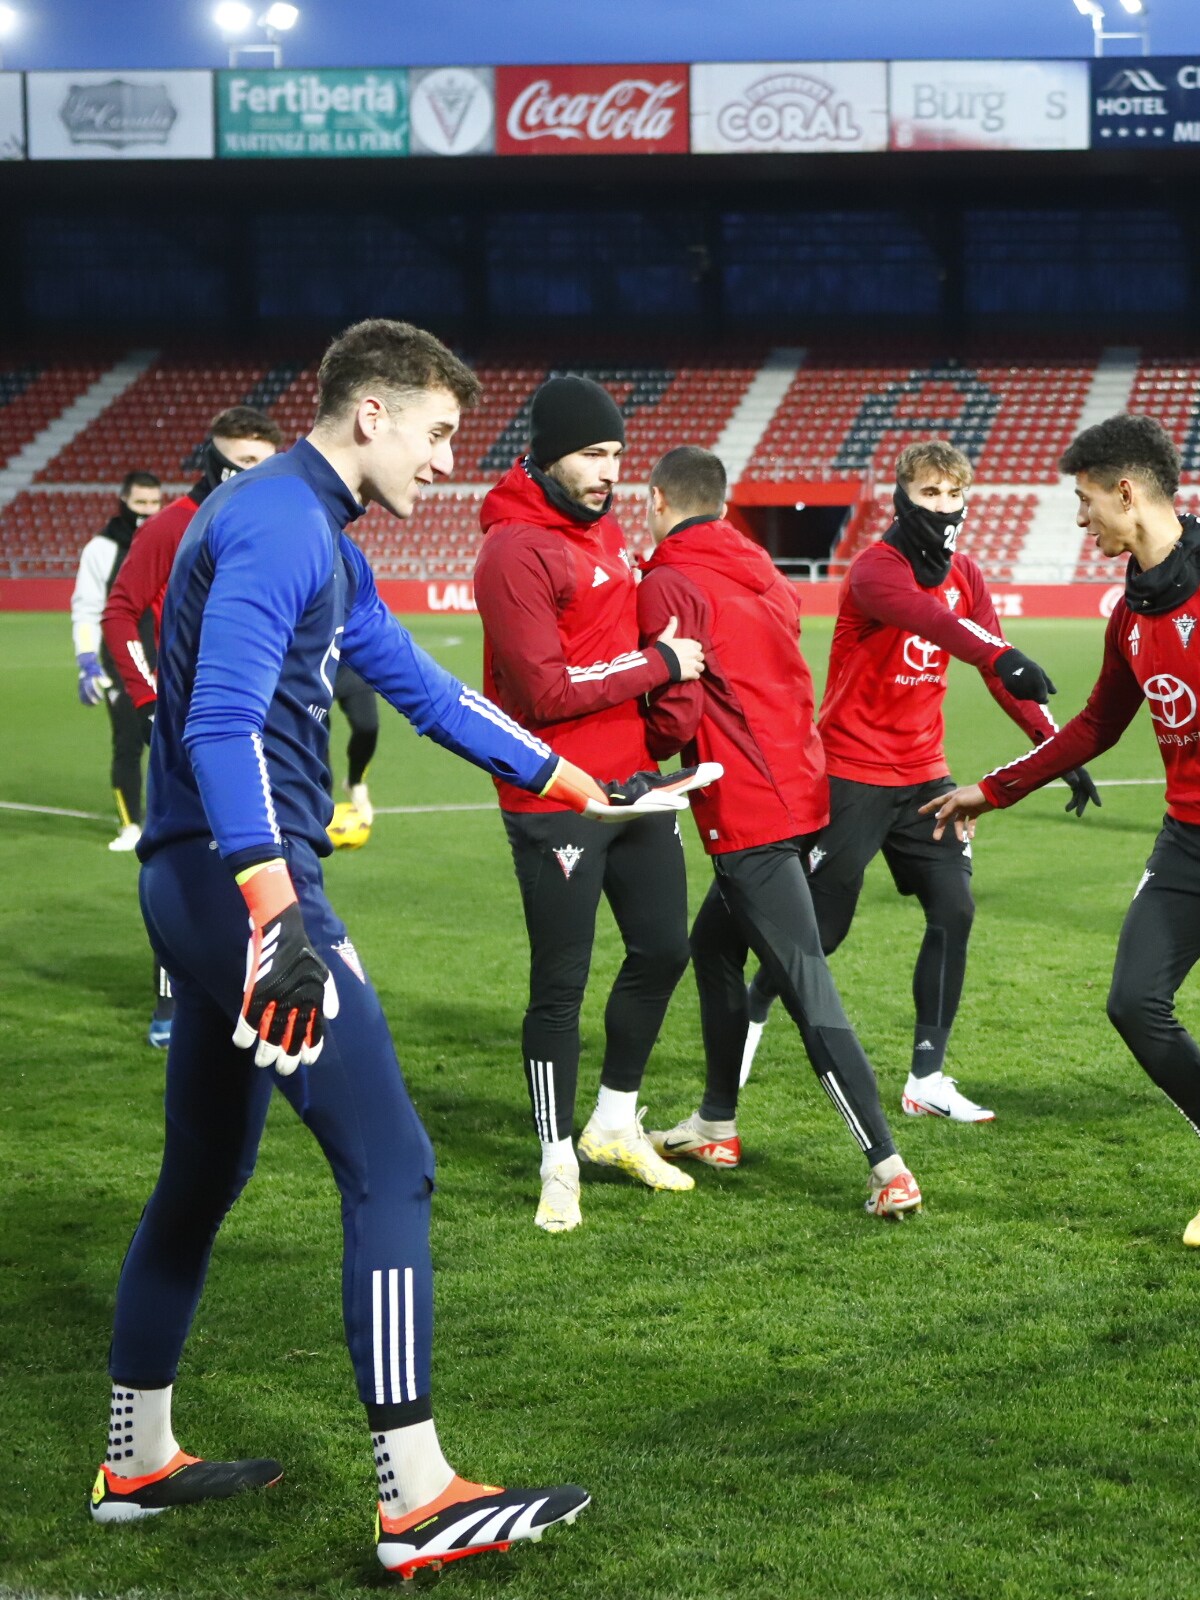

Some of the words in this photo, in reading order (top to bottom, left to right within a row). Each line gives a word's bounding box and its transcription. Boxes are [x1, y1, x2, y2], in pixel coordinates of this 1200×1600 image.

[228, 75, 397, 113] Fertiberia
[1099, 97, 1168, 115] HOTEL
[718, 102, 863, 142] CORAL
